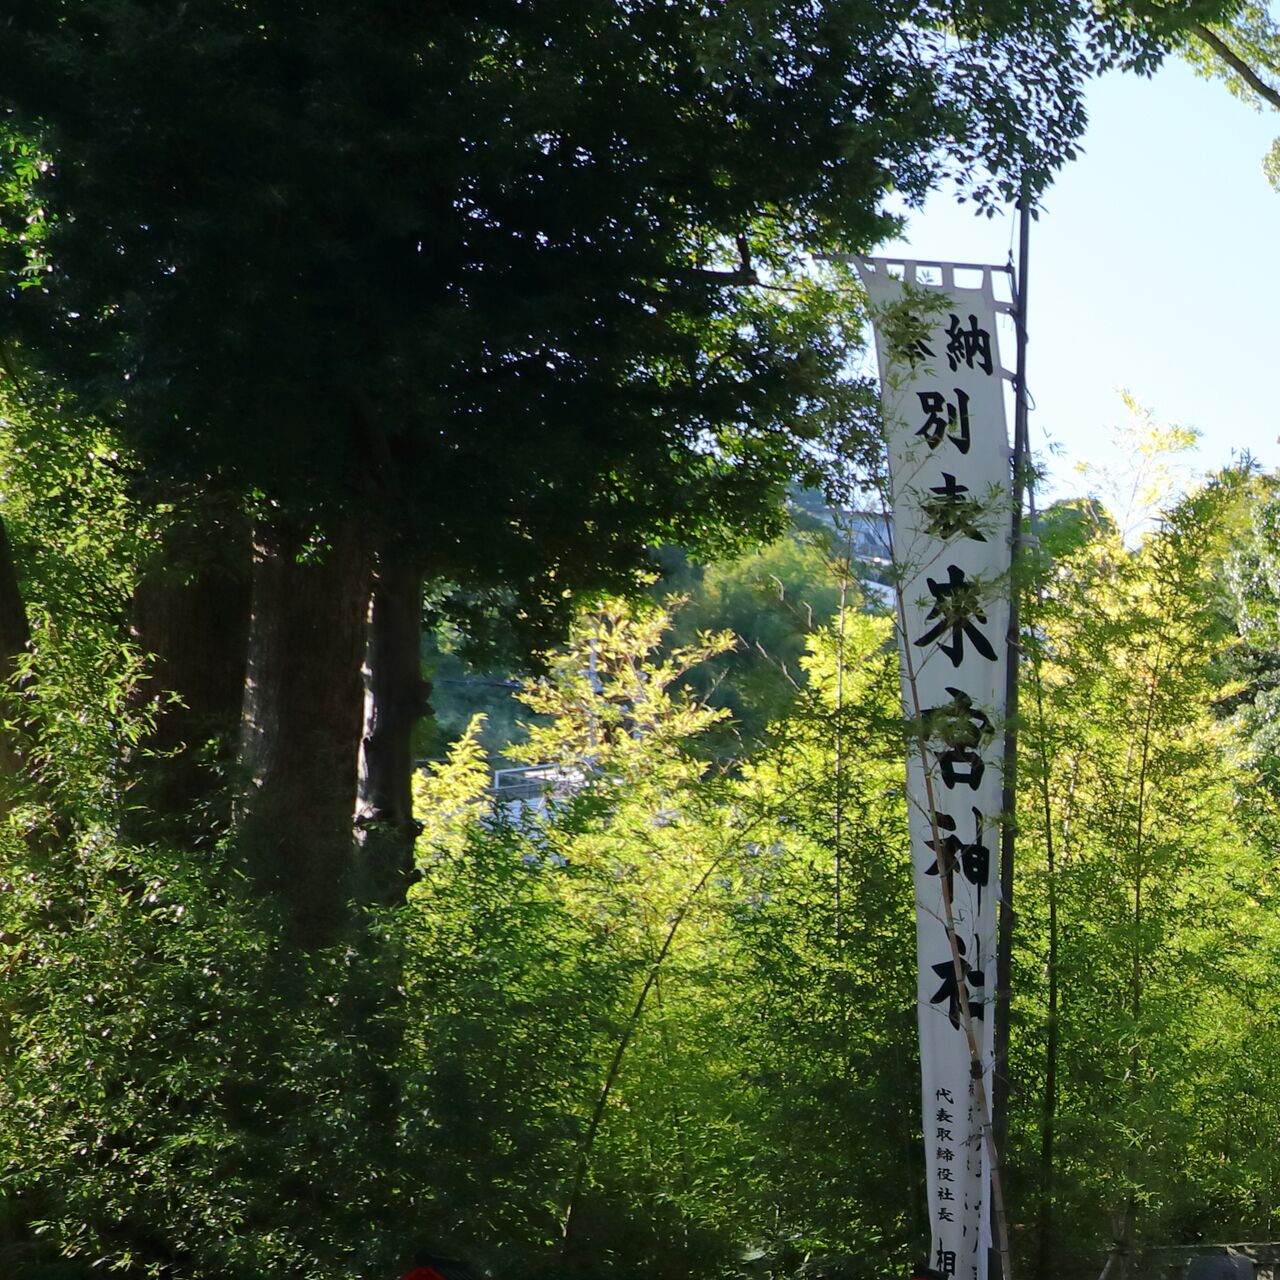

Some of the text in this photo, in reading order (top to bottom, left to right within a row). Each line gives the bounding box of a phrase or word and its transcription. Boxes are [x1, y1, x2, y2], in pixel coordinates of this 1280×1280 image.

[935, 1088, 954, 1222] 代表取締役社長
